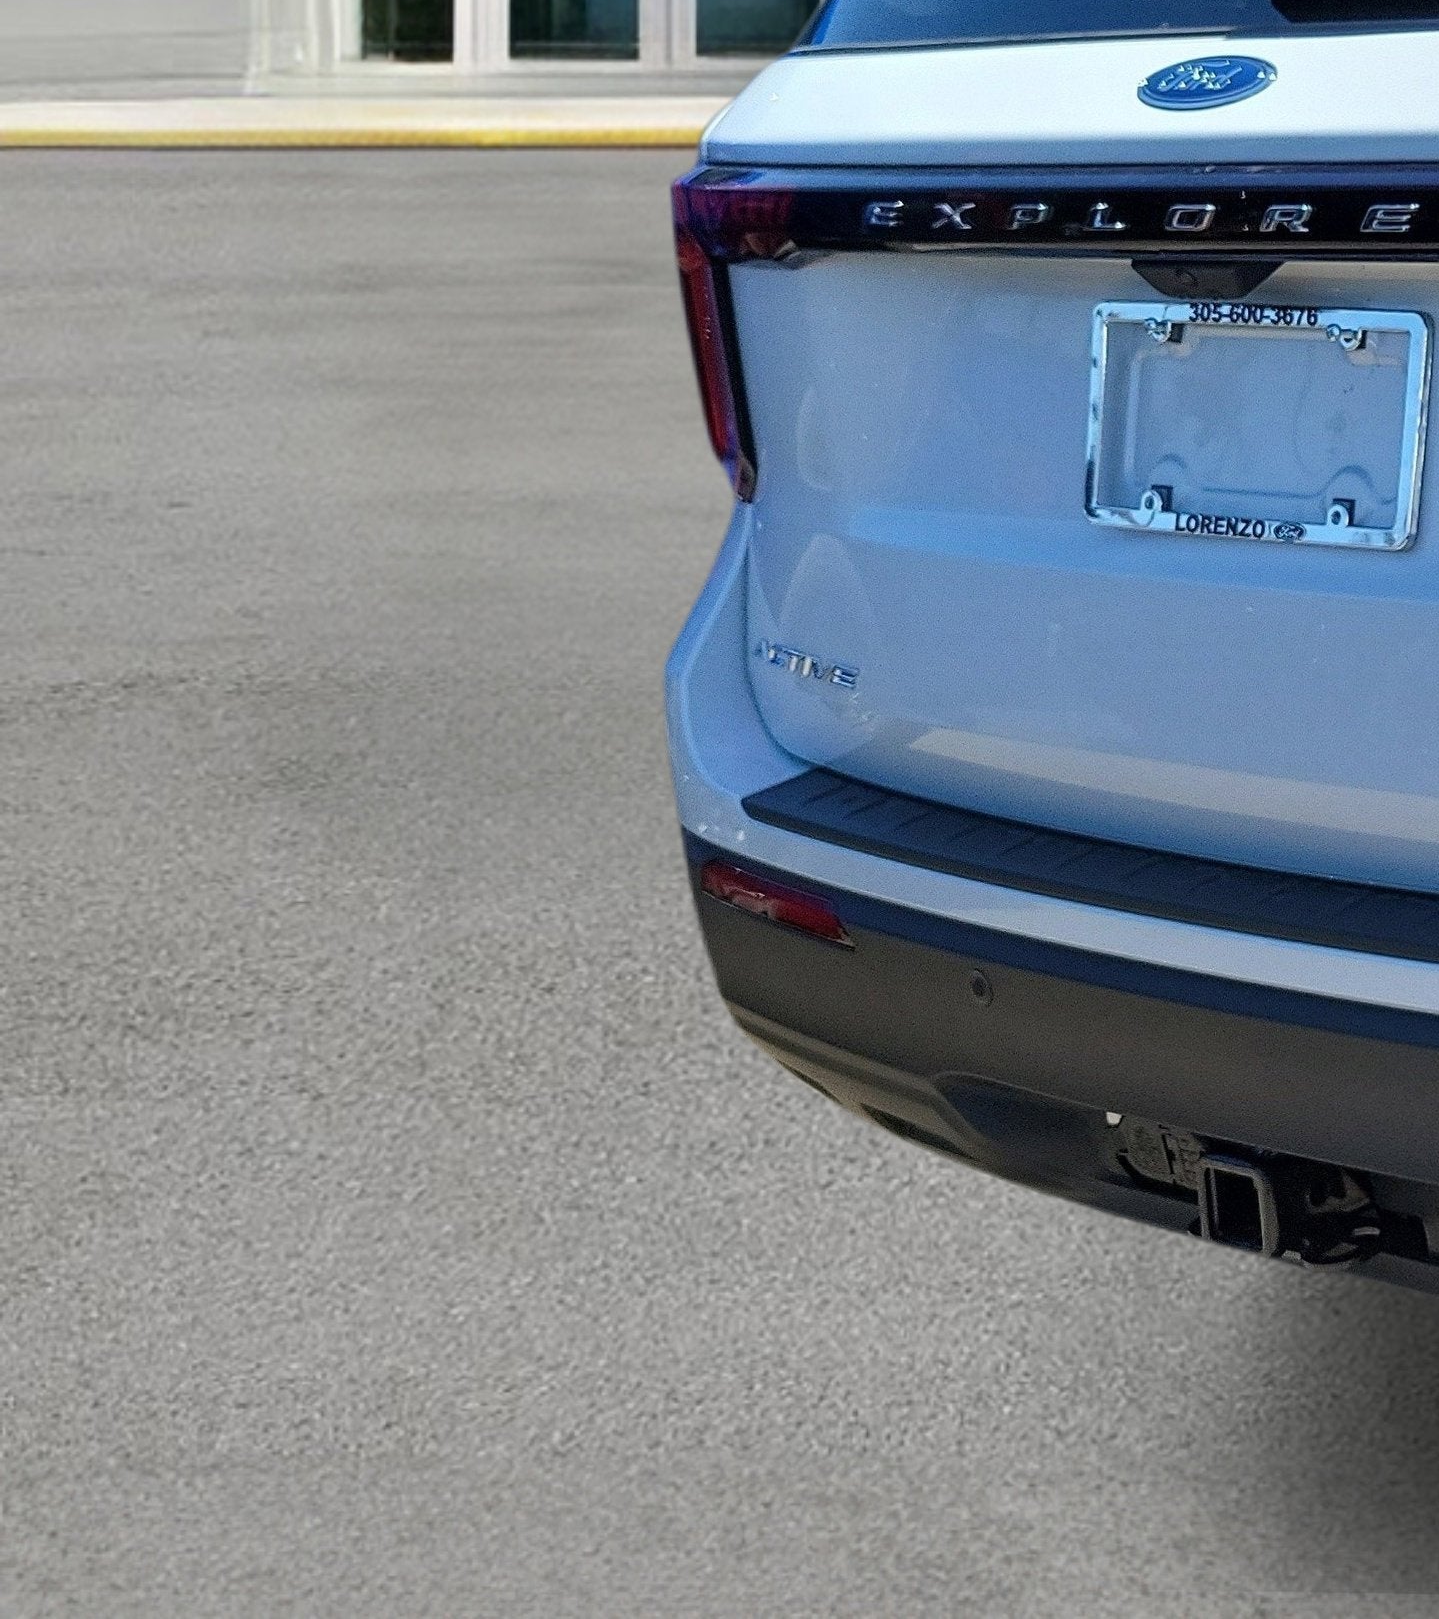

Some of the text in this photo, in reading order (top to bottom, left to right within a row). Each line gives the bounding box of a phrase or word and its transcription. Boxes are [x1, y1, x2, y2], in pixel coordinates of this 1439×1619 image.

[1157, 58, 1243, 92] Ford
[1188, 302, 1319, 327] 305-600-3676
[1175, 513, 1266, 539] LORENZO
